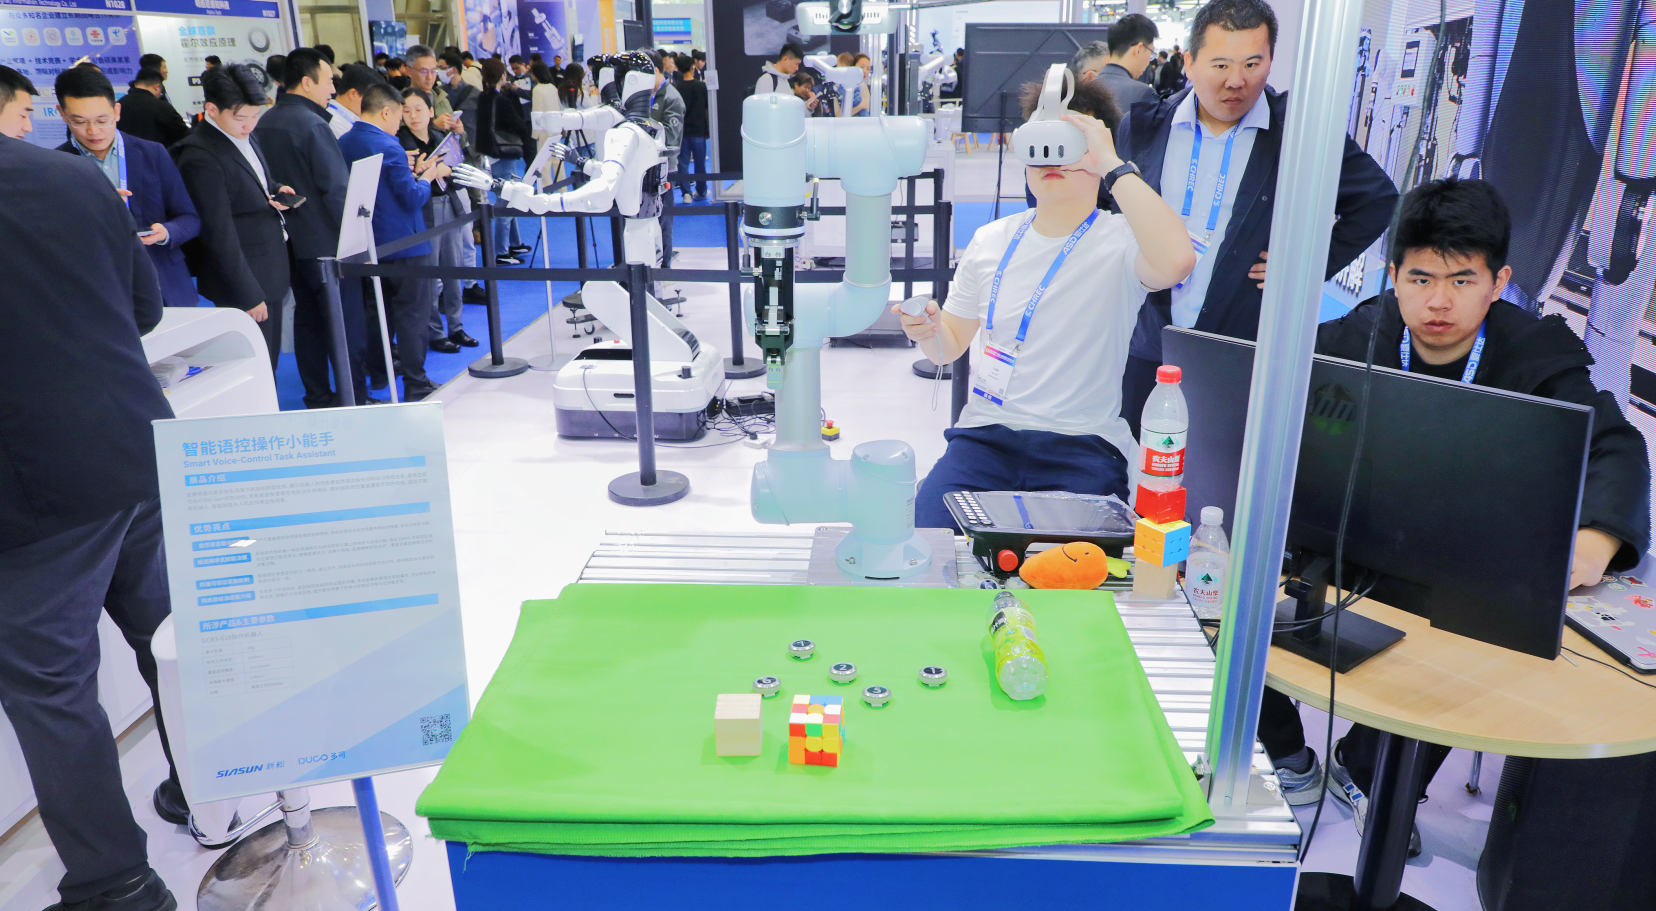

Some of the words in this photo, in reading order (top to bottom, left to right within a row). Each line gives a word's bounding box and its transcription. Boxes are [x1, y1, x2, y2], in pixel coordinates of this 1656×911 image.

[180, 37, 237, 48] 霍尔效应原理
[1186, 165, 1198, 192] CHREC
[1214, 173, 1226, 199] CHREC
[1063, 236, 1078, 255] ASD
[990, 276, 1001, 304] CHREC
[1027, 284, 1046, 311] CHREC
[1463, 360, 1478, 384] ASD
[182, 431, 335, 457] 智能语控操作小能手
[183, 459, 211, 468] Smart
[212, 454, 272, 466] Voice-Control
[275, 452, 294, 461] Task
[297, 449, 336, 459] Assistant
[189, 473, 226, 485] 展品介绍
[193, 522, 231, 533] 优势亮点
[202, 614, 276, 631] 所涉产品&主要参数
[297, 753, 328, 766] DUCO
[216, 764, 263, 778] SIASUN
